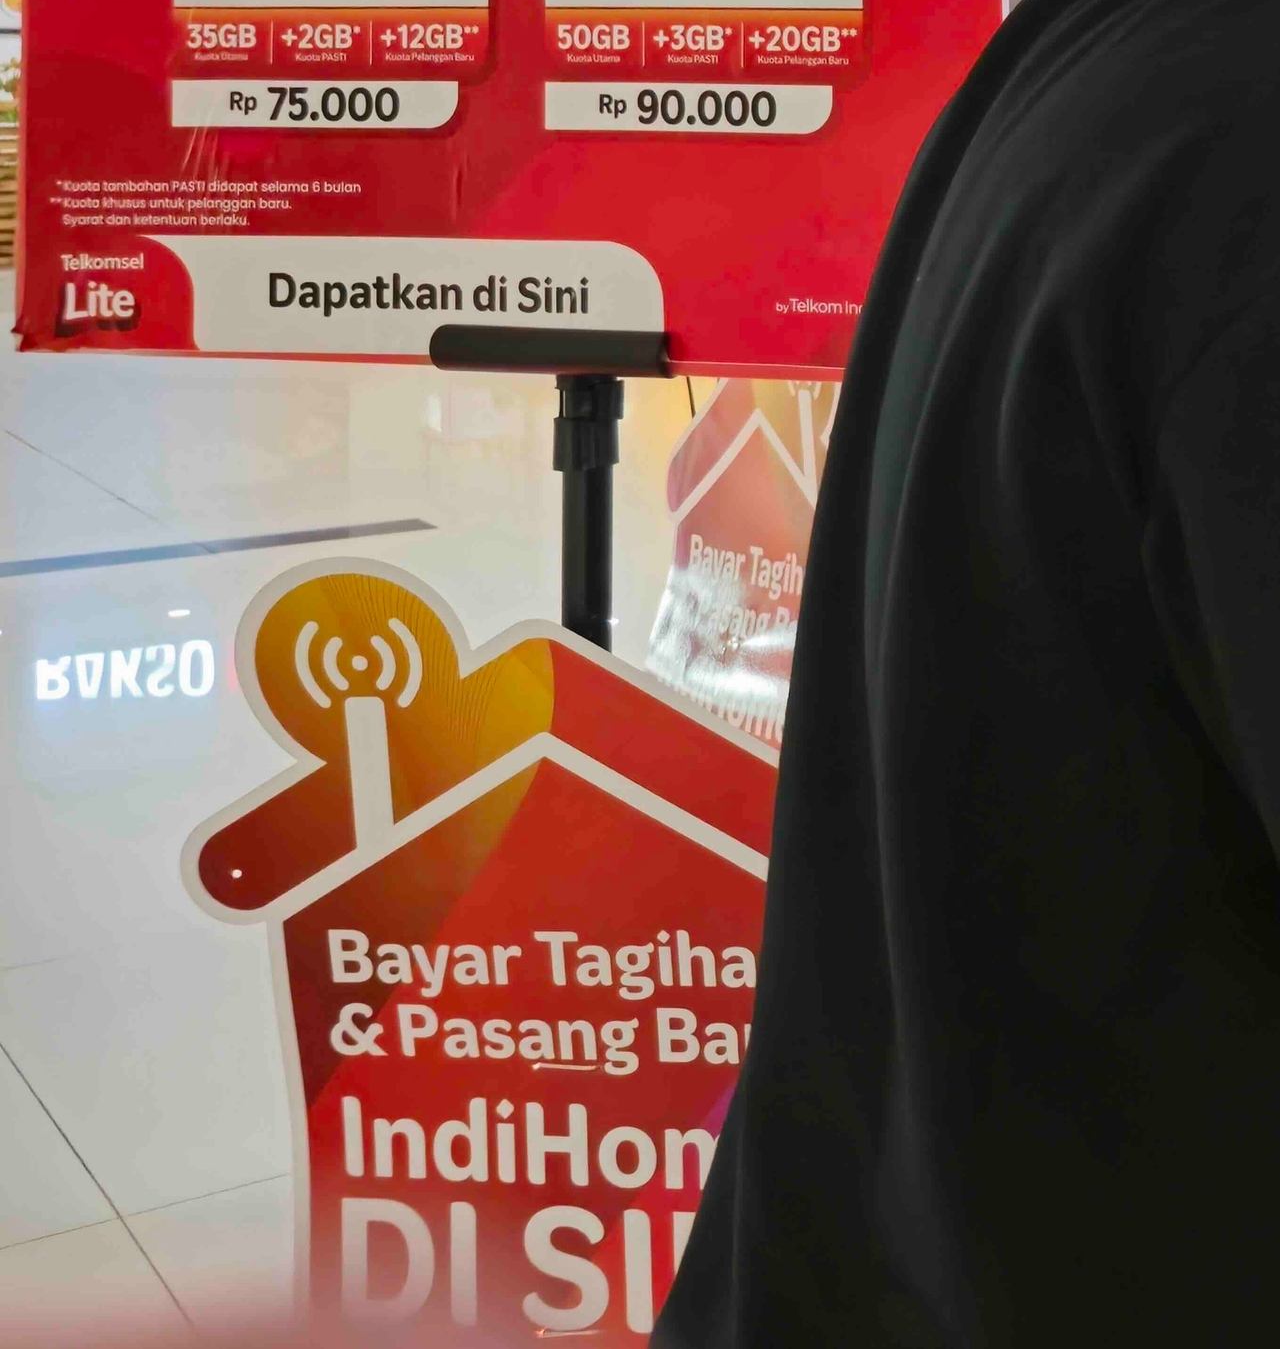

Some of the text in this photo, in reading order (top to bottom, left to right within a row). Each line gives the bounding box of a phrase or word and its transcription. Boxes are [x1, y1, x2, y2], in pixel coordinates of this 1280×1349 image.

[557, 25, 630, 50] 50GB
[229, 88, 399, 123] Rp 75.000
[599, 89, 777, 128] Rp 90.000
[103, 180, 169, 194] tambahan
[209, 181, 258, 195] didapat
[261, 181, 309, 194] selama
[312, 181, 320, 194] 6
[323, 181, 362, 194] bulan
[61, 253, 144, 272] Telkomsel
[63, 280, 136, 325] Lite
[267, 273, 588, 318] Dapatkan di Sini
[776, 302, 789, 315] by
[789, 298, 838, 313] Telkom
[690, 534, 745, 582] Bayar
[327, 928, 521, 998] Bayar
[331, 1001, 387, 1058] &
[397, 1005, 639, 1076] Pasang
[340, 1196, 478, 1329] DI
